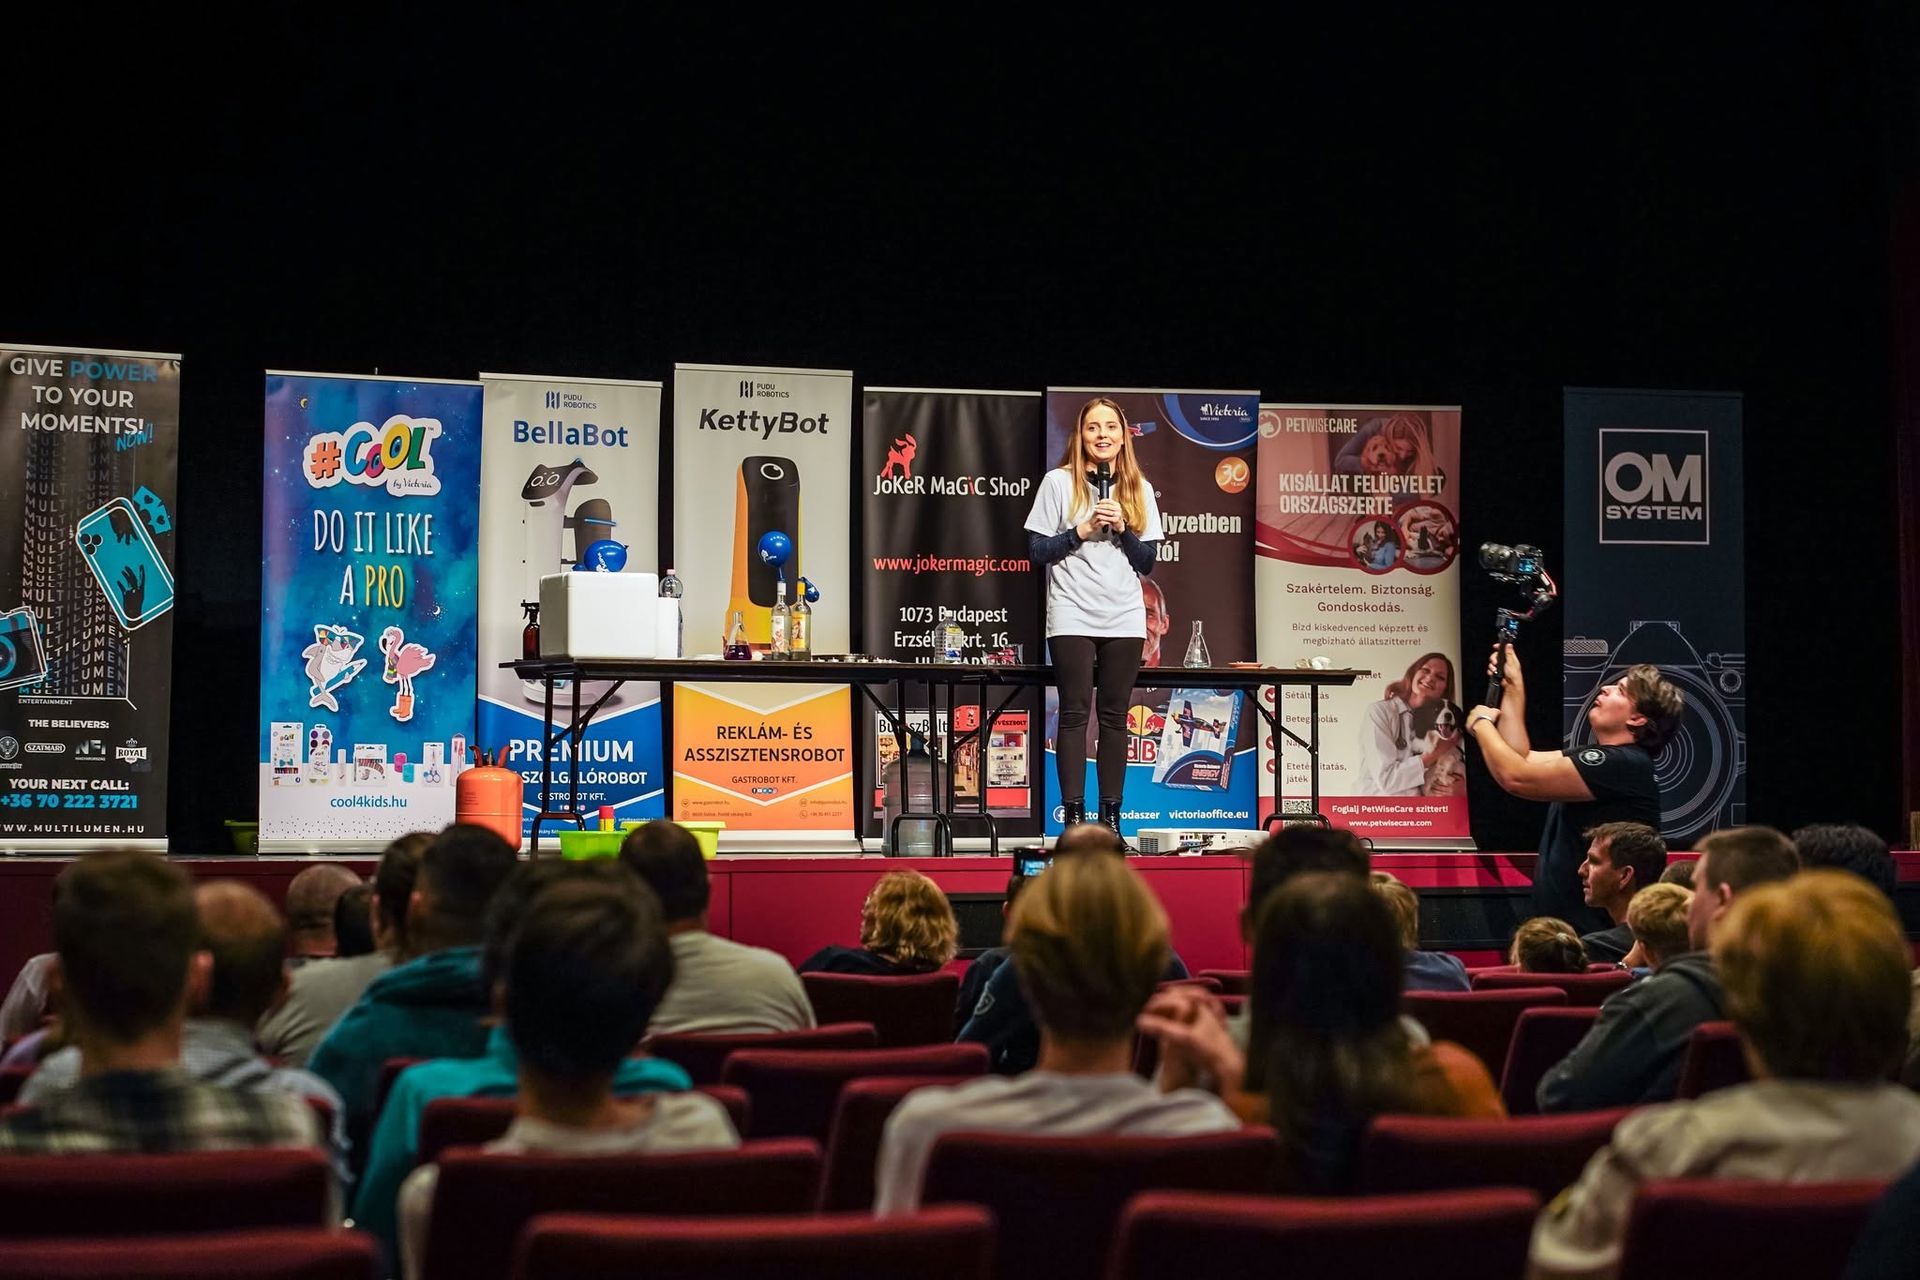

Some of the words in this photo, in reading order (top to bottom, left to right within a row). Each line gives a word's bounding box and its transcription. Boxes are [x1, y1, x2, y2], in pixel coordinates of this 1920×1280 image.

[10, 357, 63, 377] GIVE
[69, 361, 158, 382] POWER
[756, 383, 776, 391] PUDU
[32, 386, 63, 404] TO
[69, 388, 134, 408] YOUR
[1208, 403, 1249, 417] Victoria
[21, 412, 144, 434] MOMENTS!
[699, 408, 830, 440] KettyBot
[1285, 417, 1358, 434] PETWISECARE
[116, 424, 153, 452] NOW!
[513, 420, 629, 447] BellaBot
[393, 479, 401, 489] by
[403, 477, 432, 489] Victoria
[1279, 470, 1350, 493] KISÁLLAT
[1353, 472, 1445, 494] FELÜGYELET
[1604, 452, 1702, 503] OM
[873, 475, 926, 495] JoKeR
[930, 476, 986, 496] MaGiC
[989, 477, 1031, 496] ShoP
[1279, 494, 1393, 515] ORSZÁGSZERTE
[1606, 505, 1702, 520] SYSTEM
[314, 509, 345, 553] DO
[353, 511, 376, 553] IT
[386, 512, 434, 555] LIKE
[873, 554, 1031, 577] www.jokermagic.com
[339, 564, 355, 605] A
[365, 564, 405, 608] PRO
[1286, 583, 1367, 595] Szakértelem.
[1371, 584, 1435, 597] Biztonság.
[900, 606, 933, 623] 1073
[1317, 602, 1405, 613] Gondoskodás.
[1314, 623, 1376, 632] kiskedvenced
[1379, 624, 1414, 635] képzett
[1417, 624, 1429, 632] és
[991, 632, 1009, 648] 16
[1358, 637, 1421, 646] állatszitterre!
[18, 698, 73, 706] ENTERTAINMENT
[28, 719, 49, 728] THE
[52, 720, 109, 729] BELIEVERS:
[717, 722, 788, 740] REKLÁM-
[793, 722, 813, 740] ÉS
[118, 749, 145, 758] ROYAL
[684, 748, 845, 762] ASSZISZTENSROBOT
[9, 778, 48, 790] YOUR
[52, 779, 88, 790] NEXT
[91, 780, 129, 790] CALL:
[731, 776, 779, 784] GASTROBOT
[781, 776, 798, 784] KFT.
[1286, 774, 1309, 785] játék
[2, 794, 32, 808] +36
[36, 794, 59, 808] 70
[64, 795, 95, 808] 222
[99, 795, 138, 809] 3721
[330, 796, 407, 808] cool4kids.hu
[589, 793, 607, 801] KFT.
[1169, 809, 1249, 820] victoriaoffice.eu
[1332, 805, 1359, 814] Foglalj
[1361, 805, 1413, 813] PetWiseCare
[1416, 805, 1449, 813] szittert!
[0, 824, 145, 833] WW.MULTILUMEN.HU
[1348, 820, 1432, 828] www.petwisecare.com
